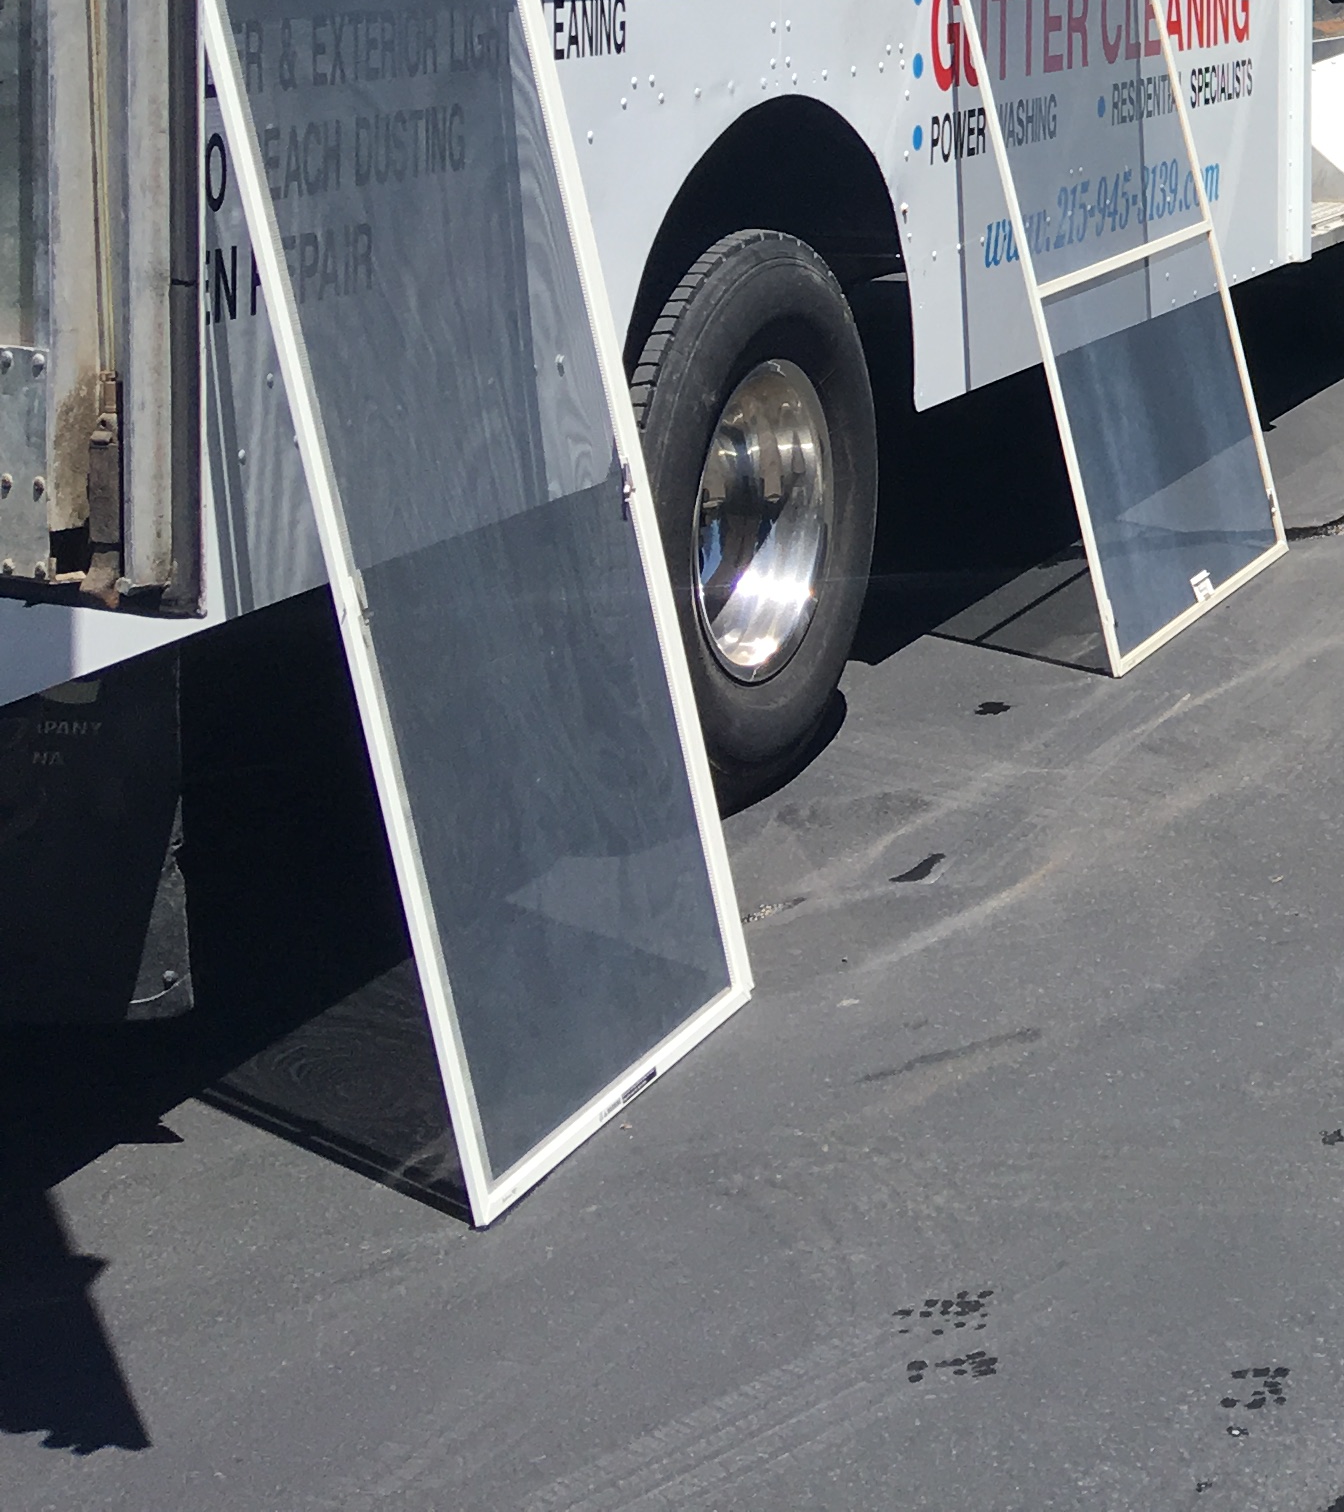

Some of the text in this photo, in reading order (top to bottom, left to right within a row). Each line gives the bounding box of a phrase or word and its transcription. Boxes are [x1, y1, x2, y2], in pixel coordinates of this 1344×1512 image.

[930, 107, 987, 165] POWER
[1190, 58, 1253, 109] SPECIALISTS
[257, 119, 342, 201] EACH
[37, 720, 103, 735] PANY
